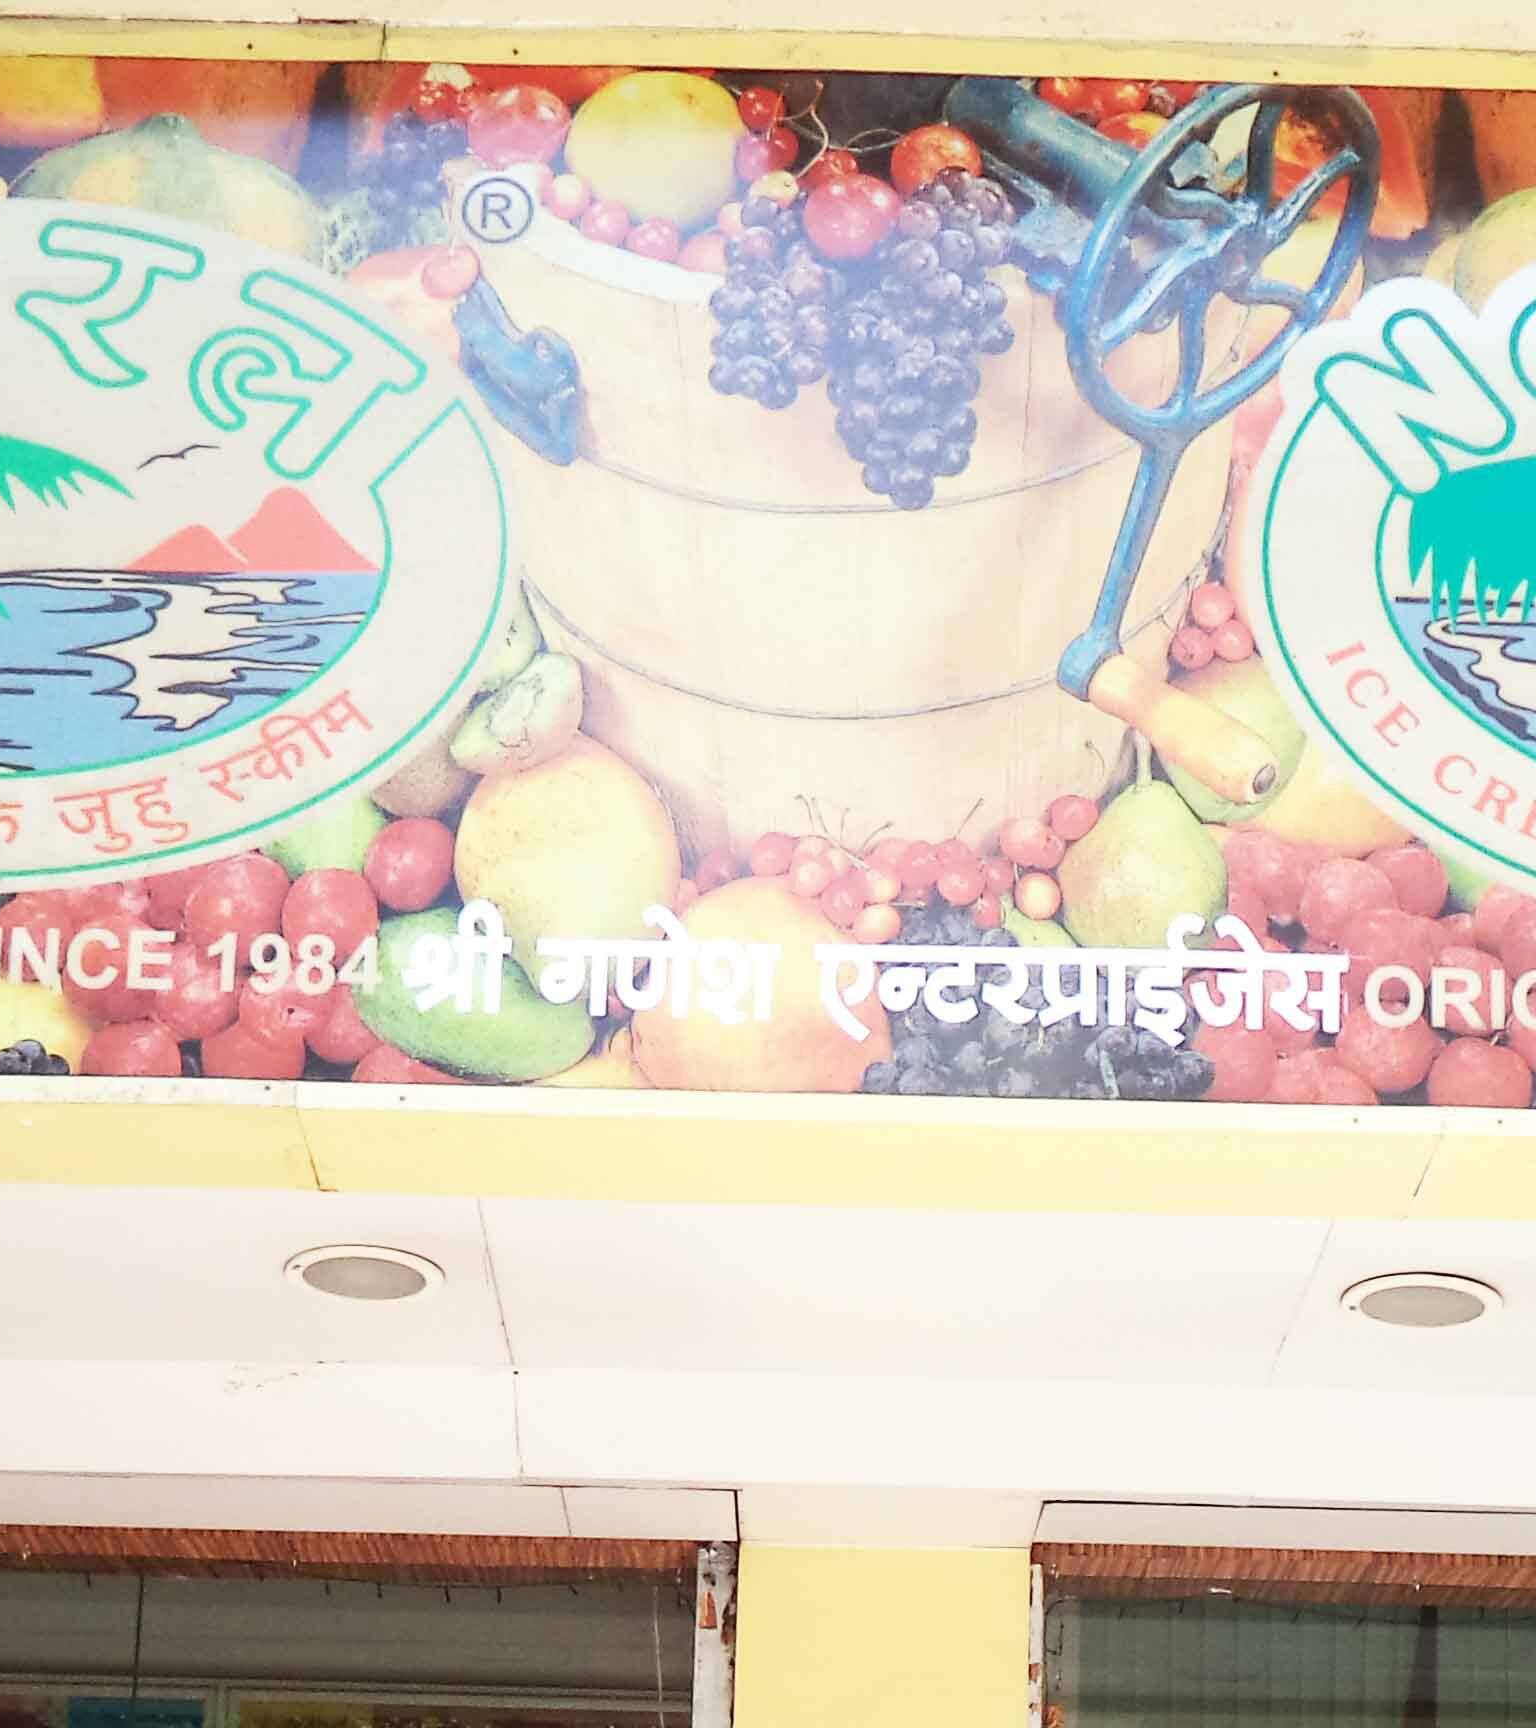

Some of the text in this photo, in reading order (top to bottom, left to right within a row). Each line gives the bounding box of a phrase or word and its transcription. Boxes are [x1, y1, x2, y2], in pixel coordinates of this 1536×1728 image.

[199, 688, 373, 804] स्कीम
[1326, 640, 1421, 748] ICE
[206, 930, 385, 998] 1984
[400, 898, 512, 1018] श्री
[534, 902, 784, 1022] गणेश
